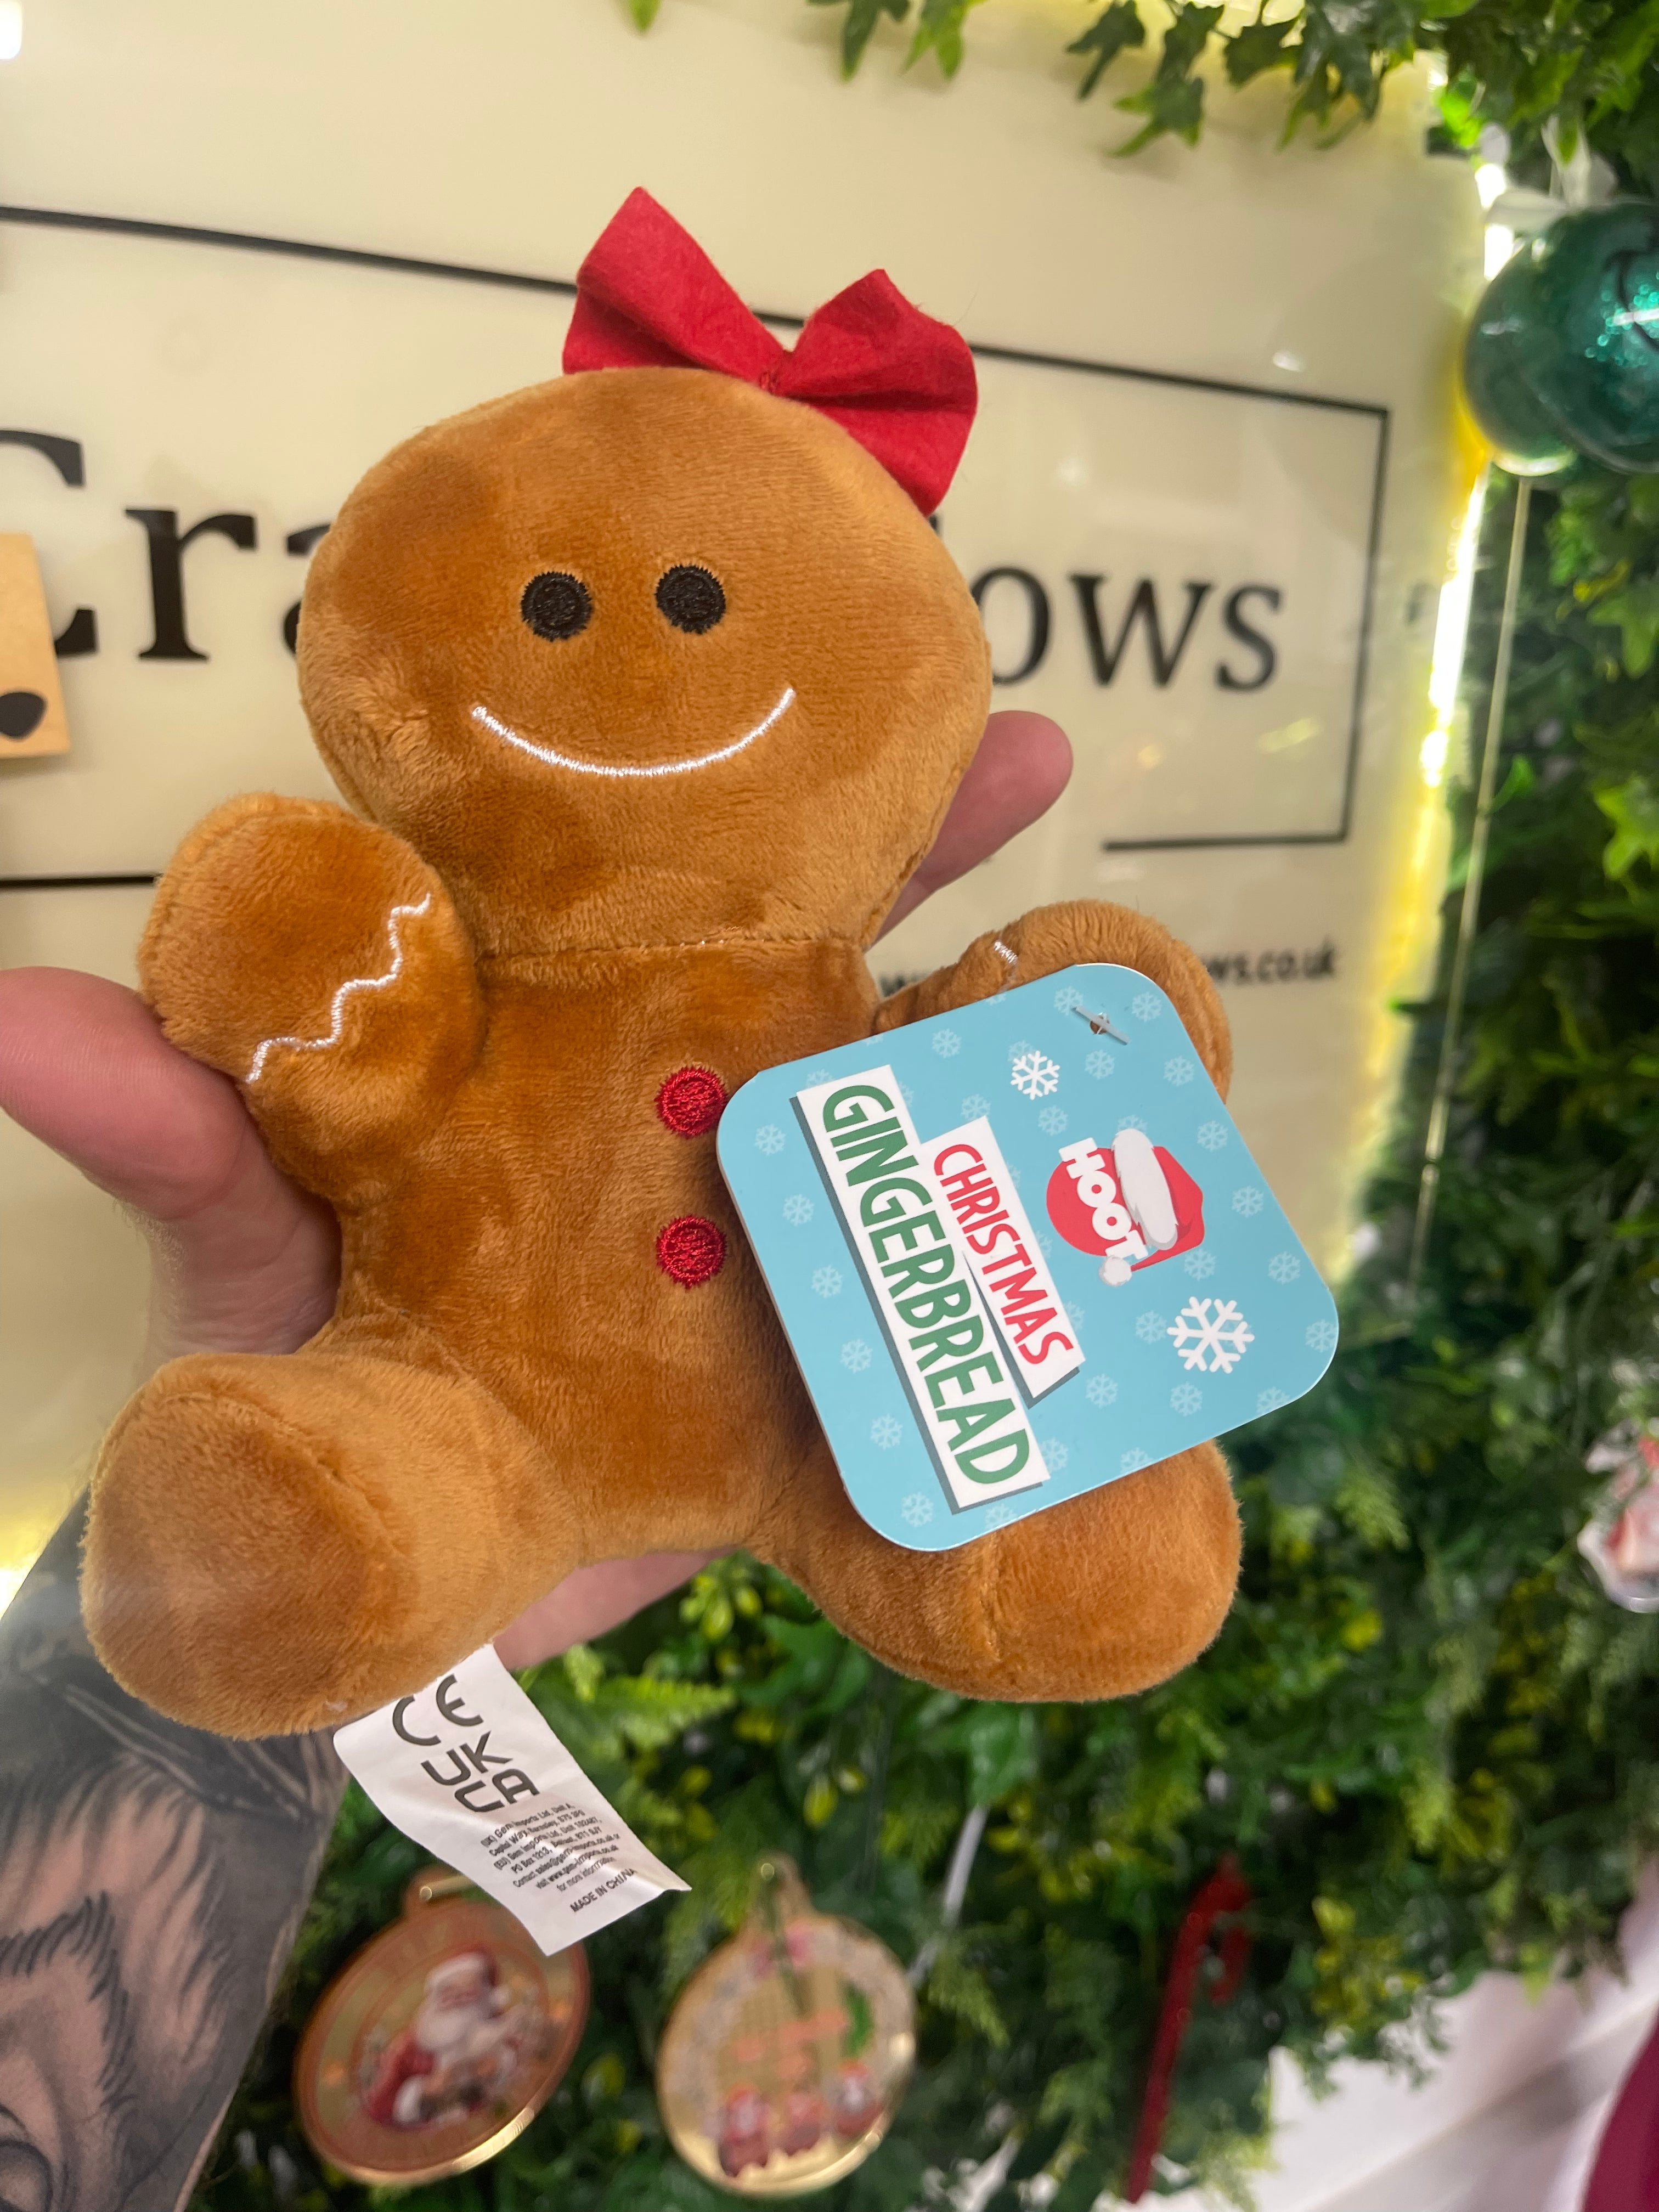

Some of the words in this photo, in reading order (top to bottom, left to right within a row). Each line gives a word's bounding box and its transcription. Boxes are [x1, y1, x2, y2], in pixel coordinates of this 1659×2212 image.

[822, 1084, 1029, 1485] GINGERBREAD
[934, 1143, 1074, 1365] CHRISTMAS
[1059, 1137, 1148, 1260] HOOT
[571, 1892, 597, 1912] MADE
[595, 1884, 607, 1897] IN
[606, 1868, 637, 1889] CHINA
